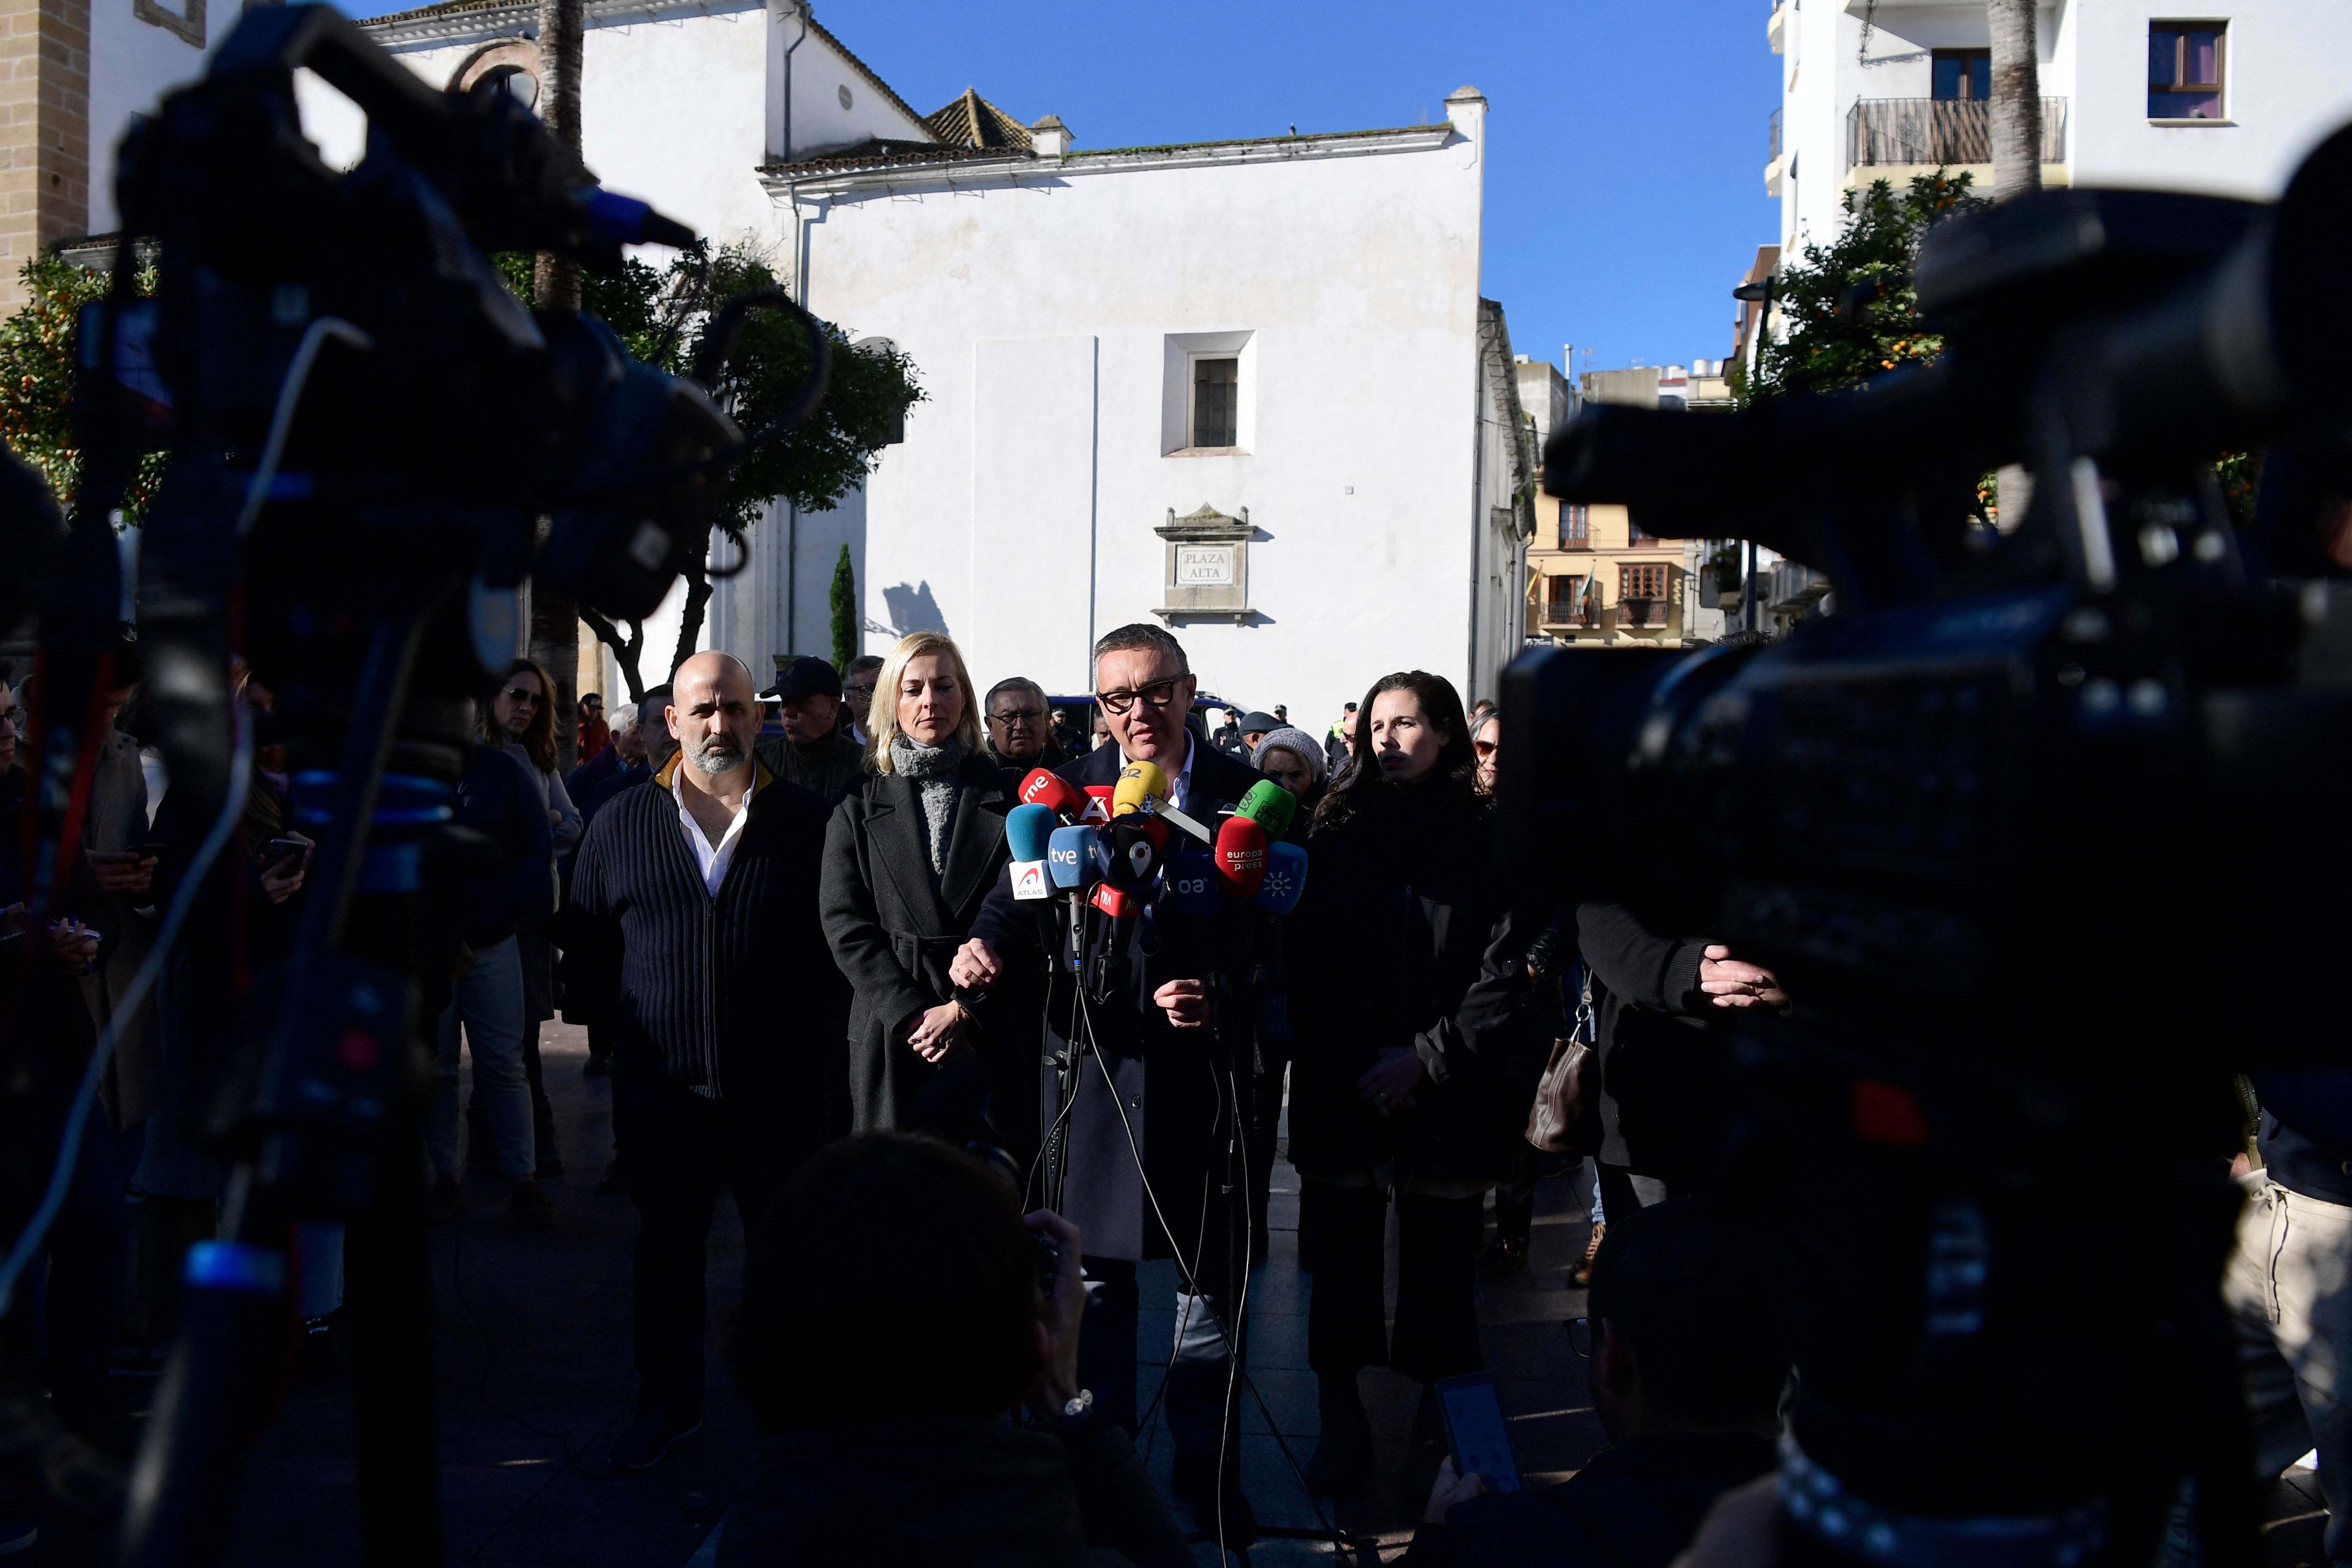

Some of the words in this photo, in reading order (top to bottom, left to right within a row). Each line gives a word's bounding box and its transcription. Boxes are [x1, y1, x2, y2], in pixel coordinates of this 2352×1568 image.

[1185, 554, 1224, 563] PLAZA
[1190, 568, 1220, 578] ALTA
[1024, 776, 1049, 803] rne
[1051, 848, 1078, 865] tve
[1227, 850, 1262, 859] europa
[1234, 861, 1262, 871] press
